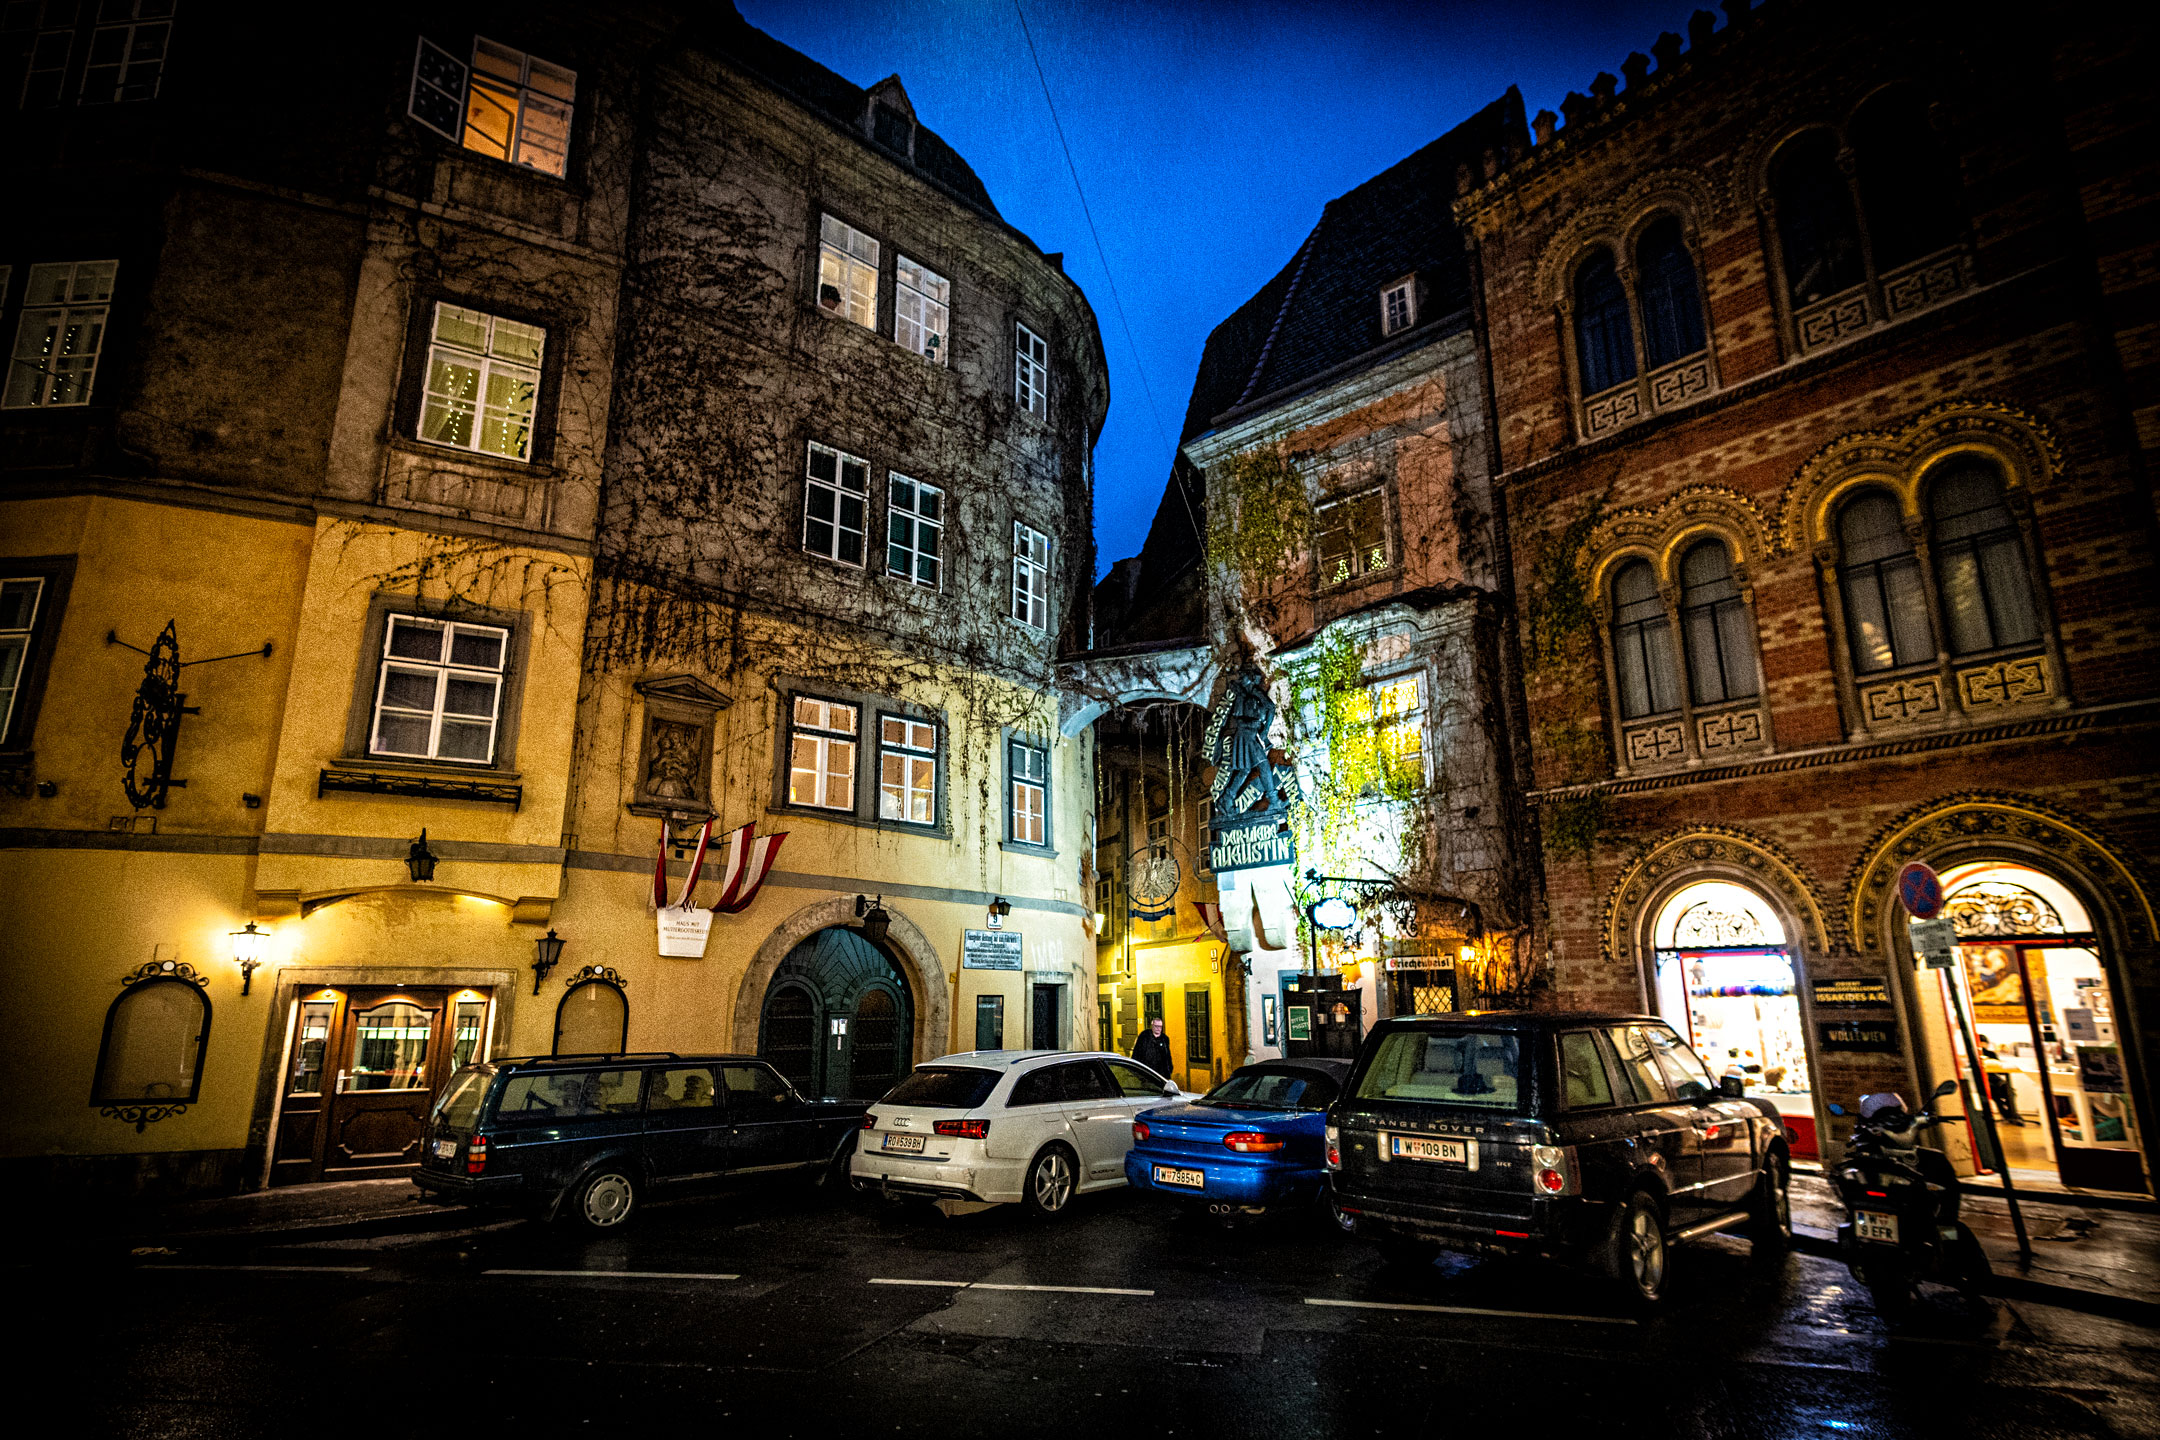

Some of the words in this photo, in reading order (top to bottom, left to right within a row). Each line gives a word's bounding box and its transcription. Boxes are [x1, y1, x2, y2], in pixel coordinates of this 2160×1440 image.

[1212, 837, 1290, 869] AUGUSTIN
[1816, 993, 1867, 1002] ISSAKIDES
[1369, 1119, 1418, 1129] RANGE
[1428, 1123, 1485, 1134] ROVER
[1405, 1141, 1413, 1154] W
[1421, 1143, 1440, 1157] 109
[1442, 1147, 1457, 1159] BN
[1161, 1171, 1167, 1180] W
[1871, 1225, 1893, 1240] EFR
